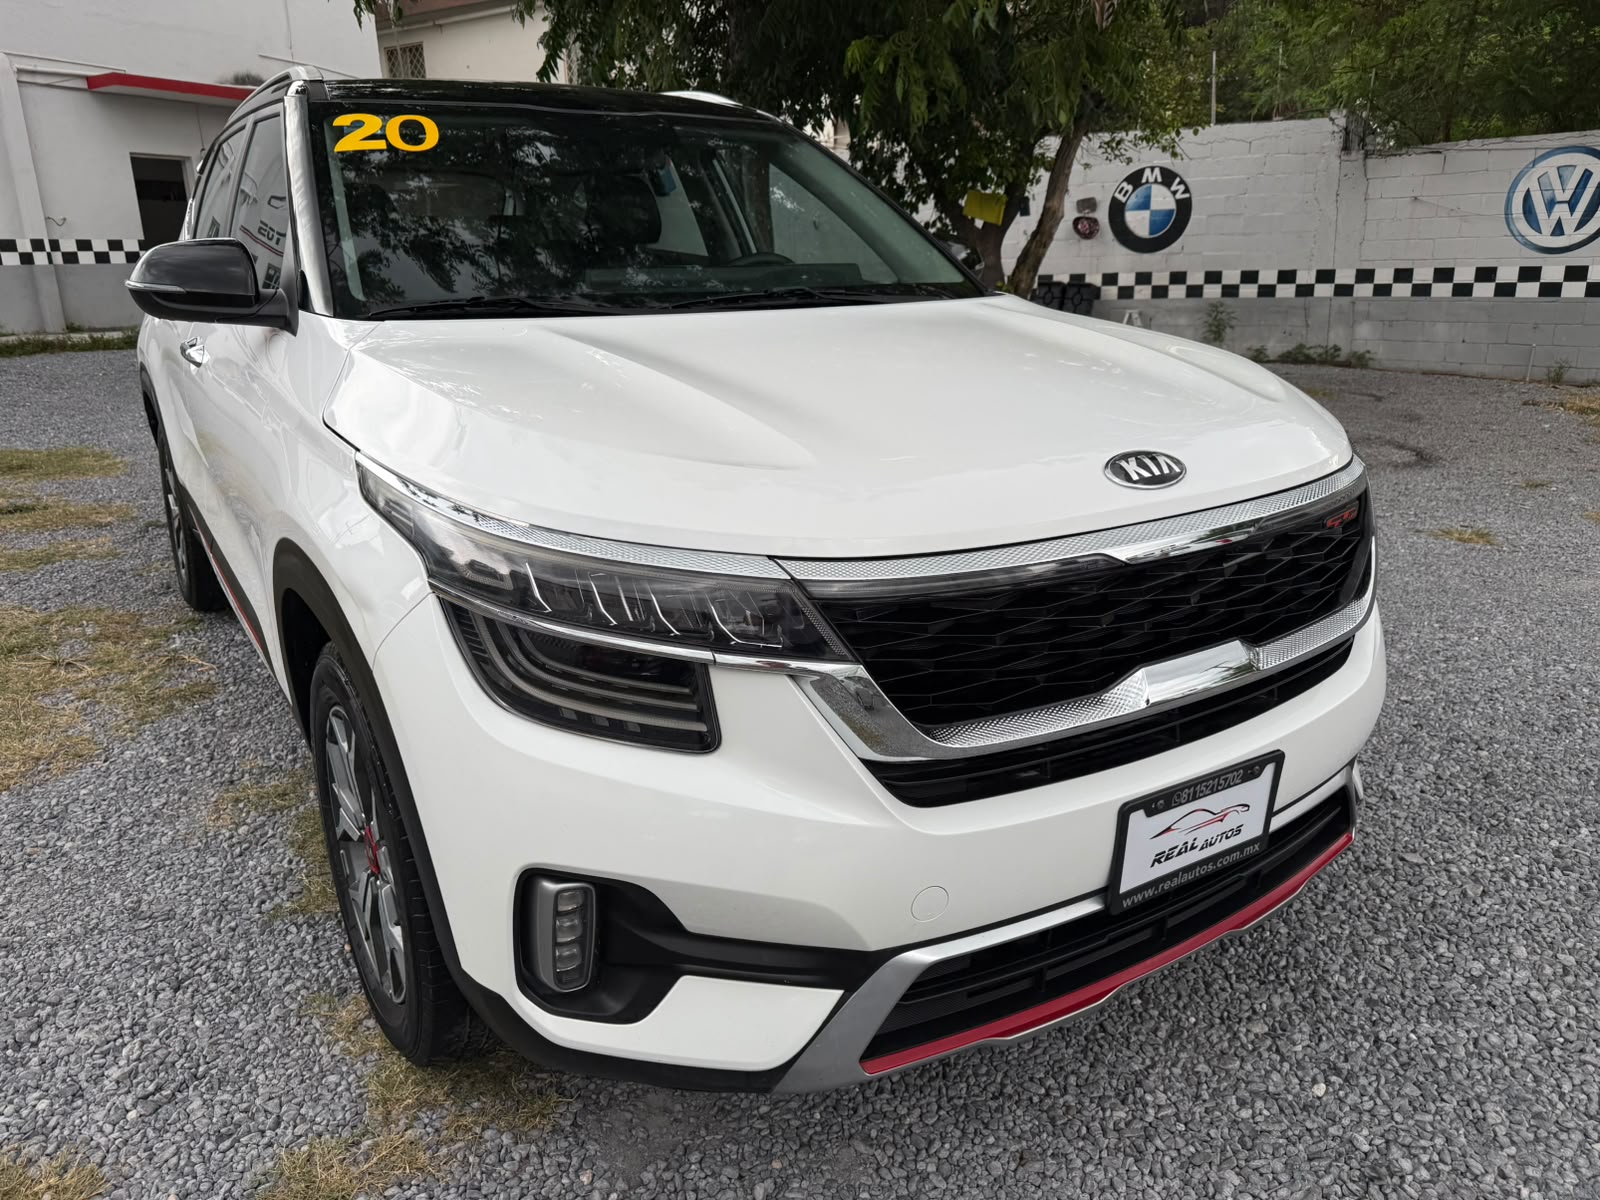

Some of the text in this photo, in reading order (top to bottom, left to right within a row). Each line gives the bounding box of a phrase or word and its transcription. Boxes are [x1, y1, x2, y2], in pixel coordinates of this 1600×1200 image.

[332, 113, 440, 153] 20
[1113, 166, 1192, 203] BMW
[1115, 453, 1182, 481] KIA
[1180, 768, 1244, 804] 8115215702
[1150, 823, 1244, 868] REAL AUTOS
[1121, 841, 1261, 909] www.realautos.com.mx
